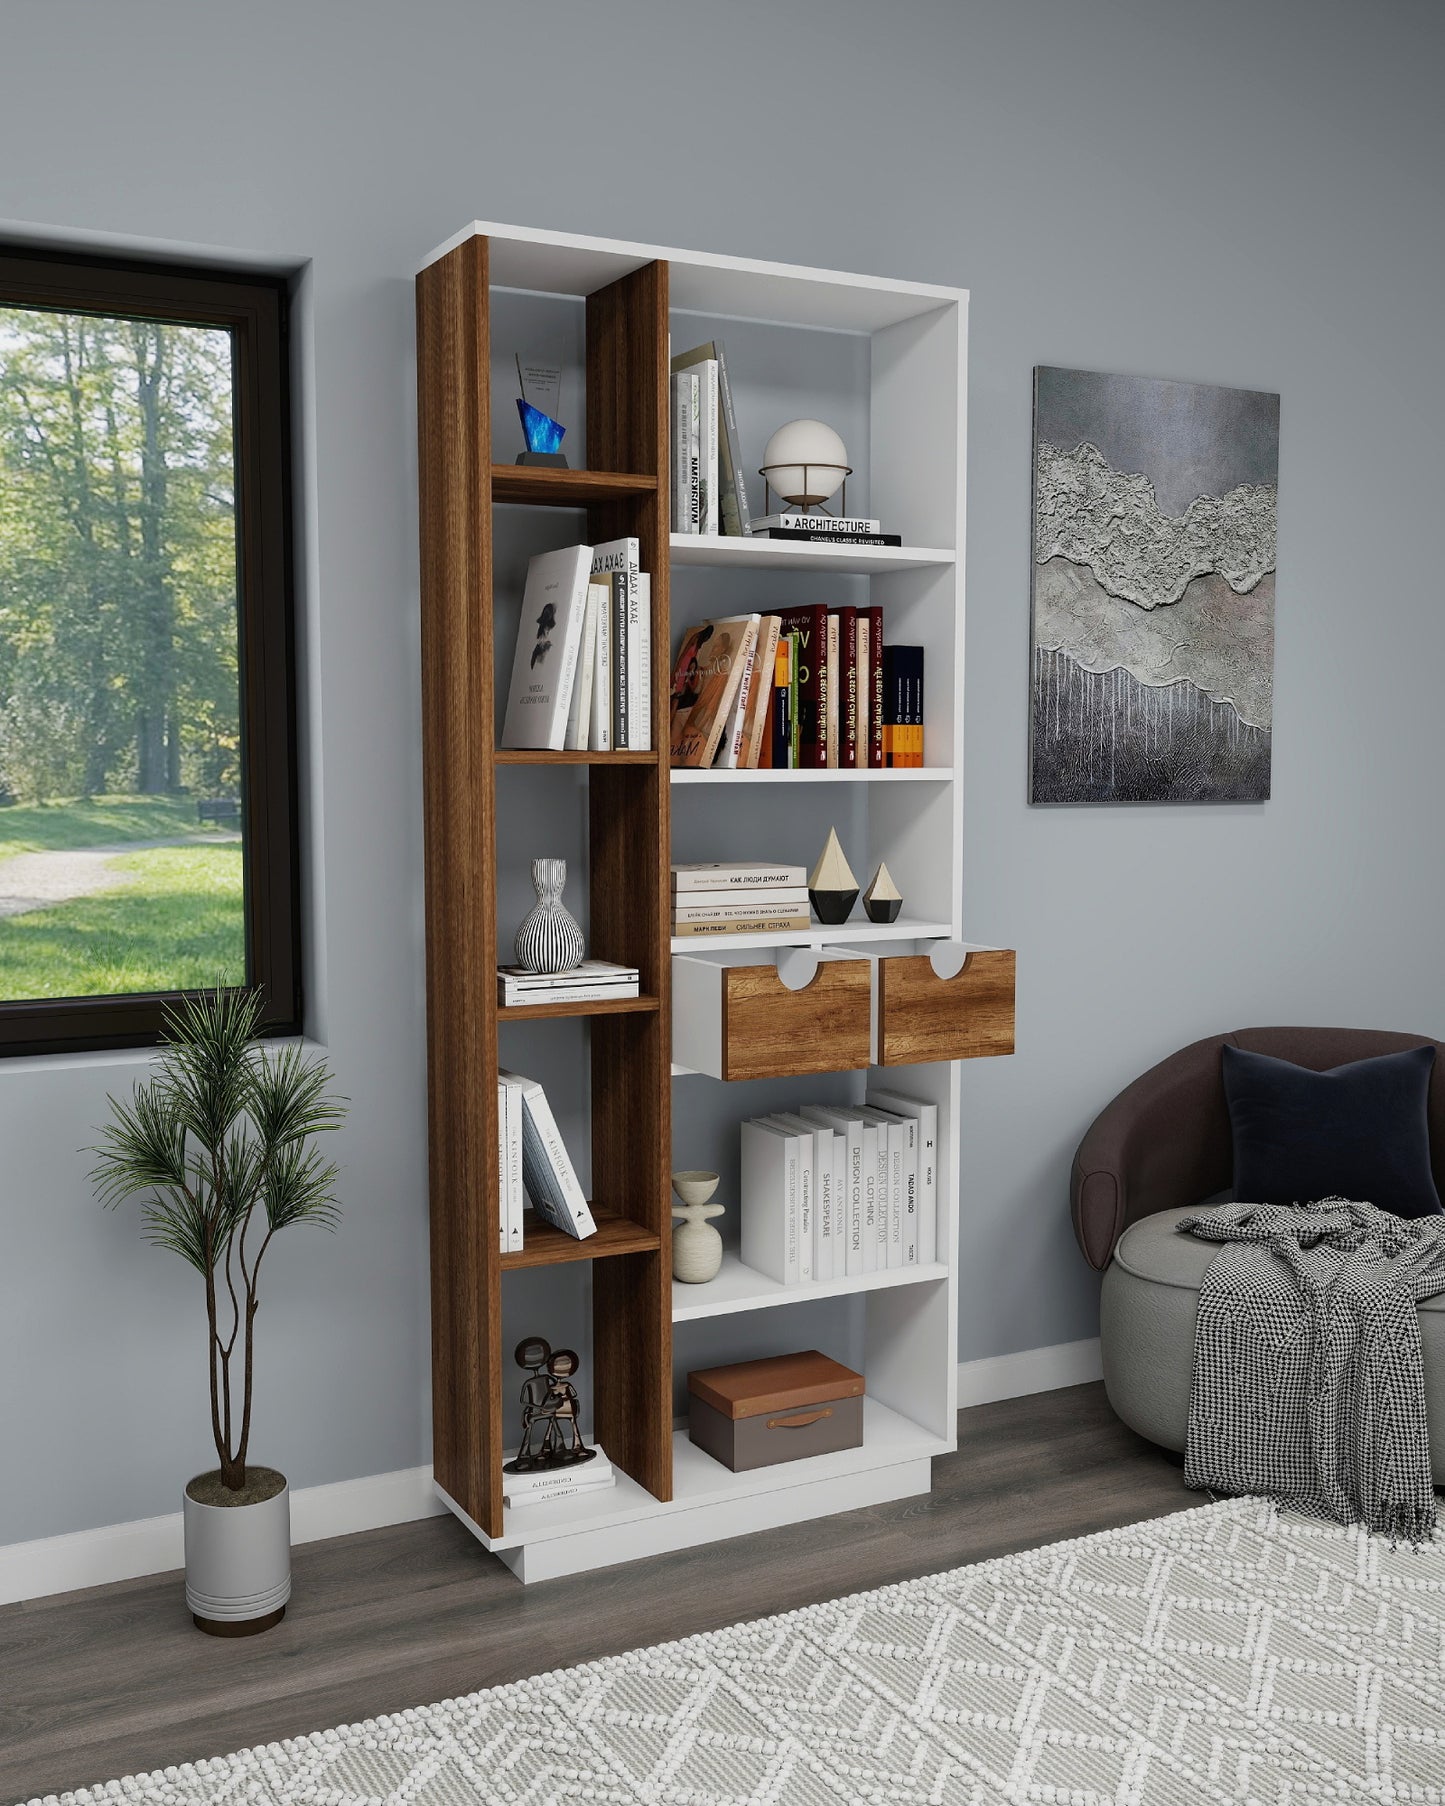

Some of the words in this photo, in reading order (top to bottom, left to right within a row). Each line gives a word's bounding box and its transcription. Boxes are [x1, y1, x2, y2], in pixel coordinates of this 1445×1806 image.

[794, 518, 870, 533] ARCHITECTURE
[836, 536, 857, 544] CLASSIC
[548, 1140, 568, 1178] KINFOLK
[852, 1147, 860, 1184] DESIGN
[878, 1150, 887, 1185] DESIGN
[852, 1187, 860, 1250] COLLECTION
[878, 1187, 887, 1243] COLLECTION
